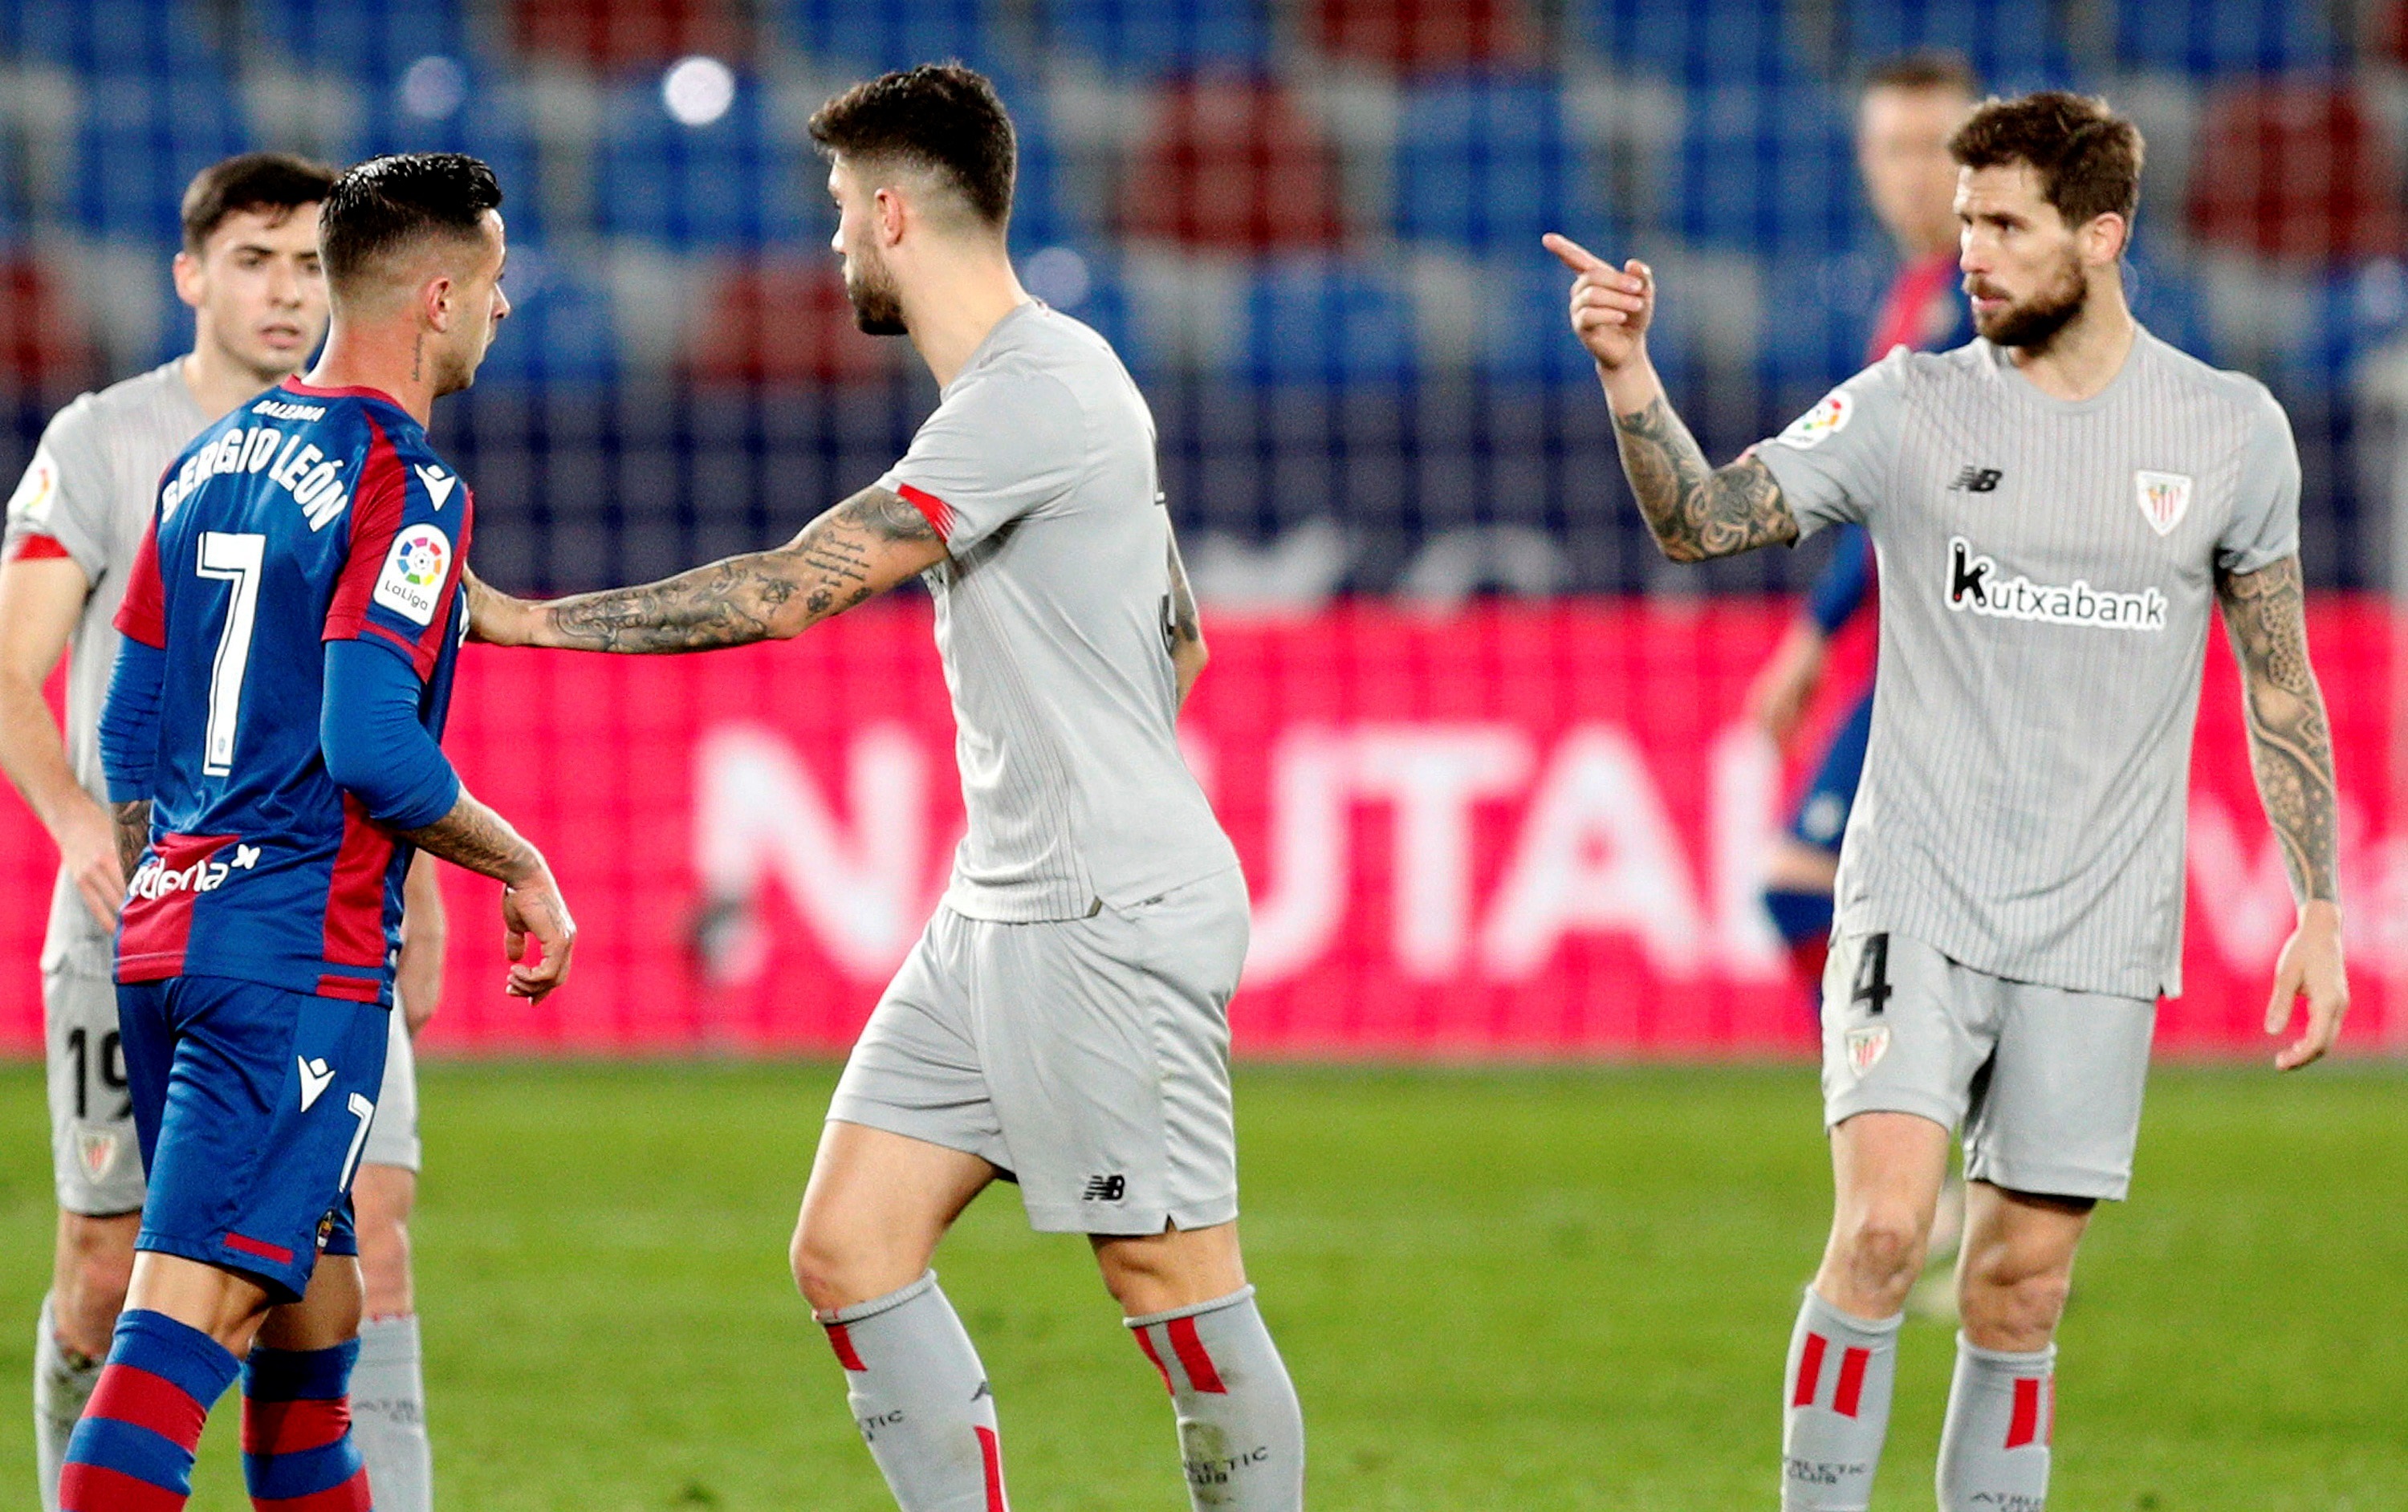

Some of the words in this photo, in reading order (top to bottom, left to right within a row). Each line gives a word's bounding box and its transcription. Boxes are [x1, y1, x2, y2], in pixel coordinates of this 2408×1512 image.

[161, 426, 282, 524] SERGIO
[267, 433, 349, 534] LEÓN
[384, 579, 429, 611] LaLiga
[1950, 541, 2164, 626] Kutxabank
[196, 530, 266, 777] 7
[1850, 932, 1893, 1017] 4
[67, 1026, 134, 1121] 19
[339, 1091, 375, 1194] 7
